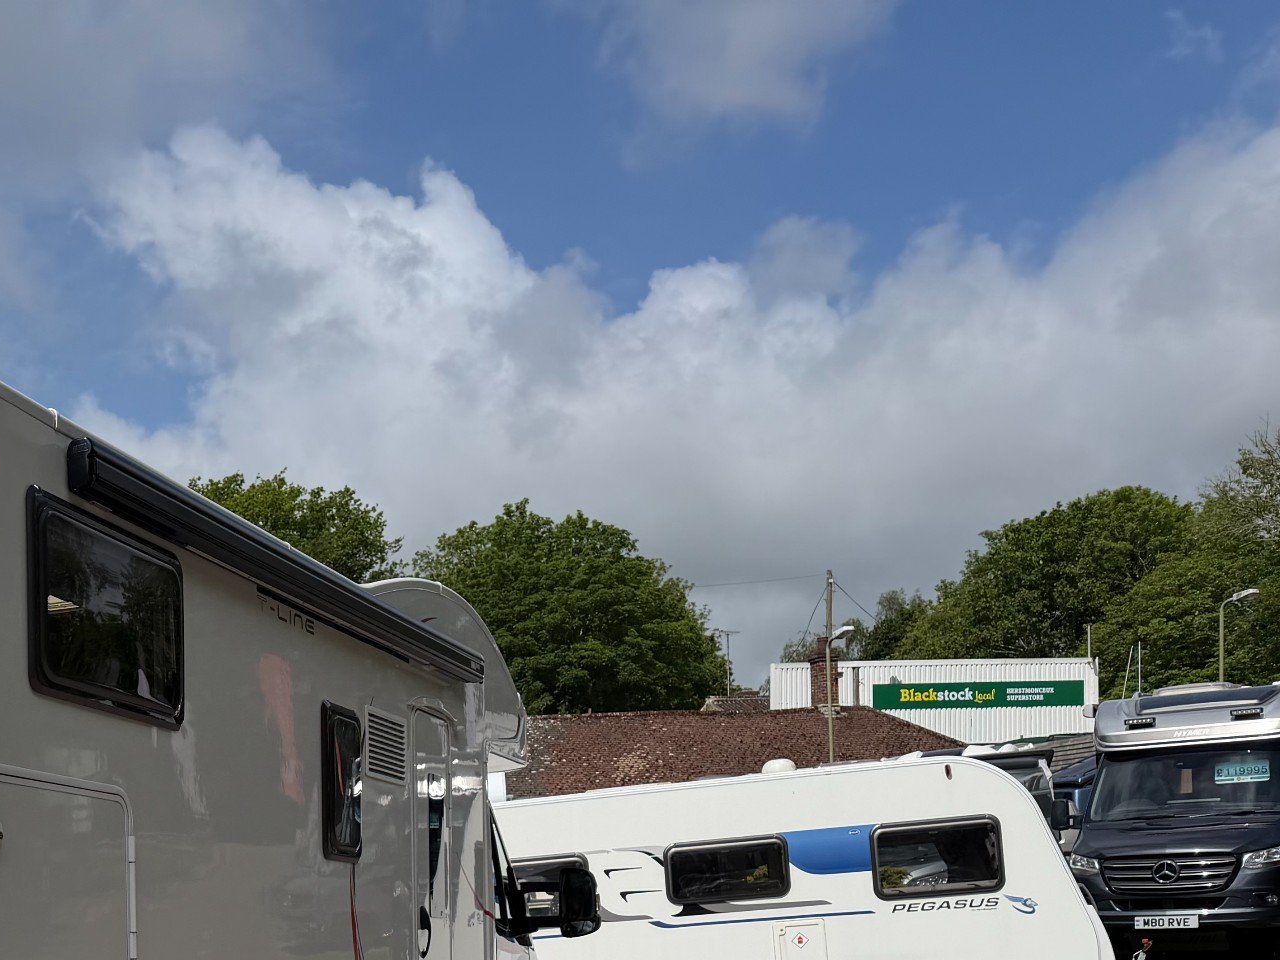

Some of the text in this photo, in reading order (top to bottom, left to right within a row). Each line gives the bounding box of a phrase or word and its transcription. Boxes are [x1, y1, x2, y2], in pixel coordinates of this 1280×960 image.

[899, 687, 996, 704] Blackstock Local
[1173, 728, 1210, 738] HYMER
[1216, 765, 1268, 778] £119995
[891, 897, 1000, 914] PEGASUS
[1143, 917, 1191, 928] M80 RVE
